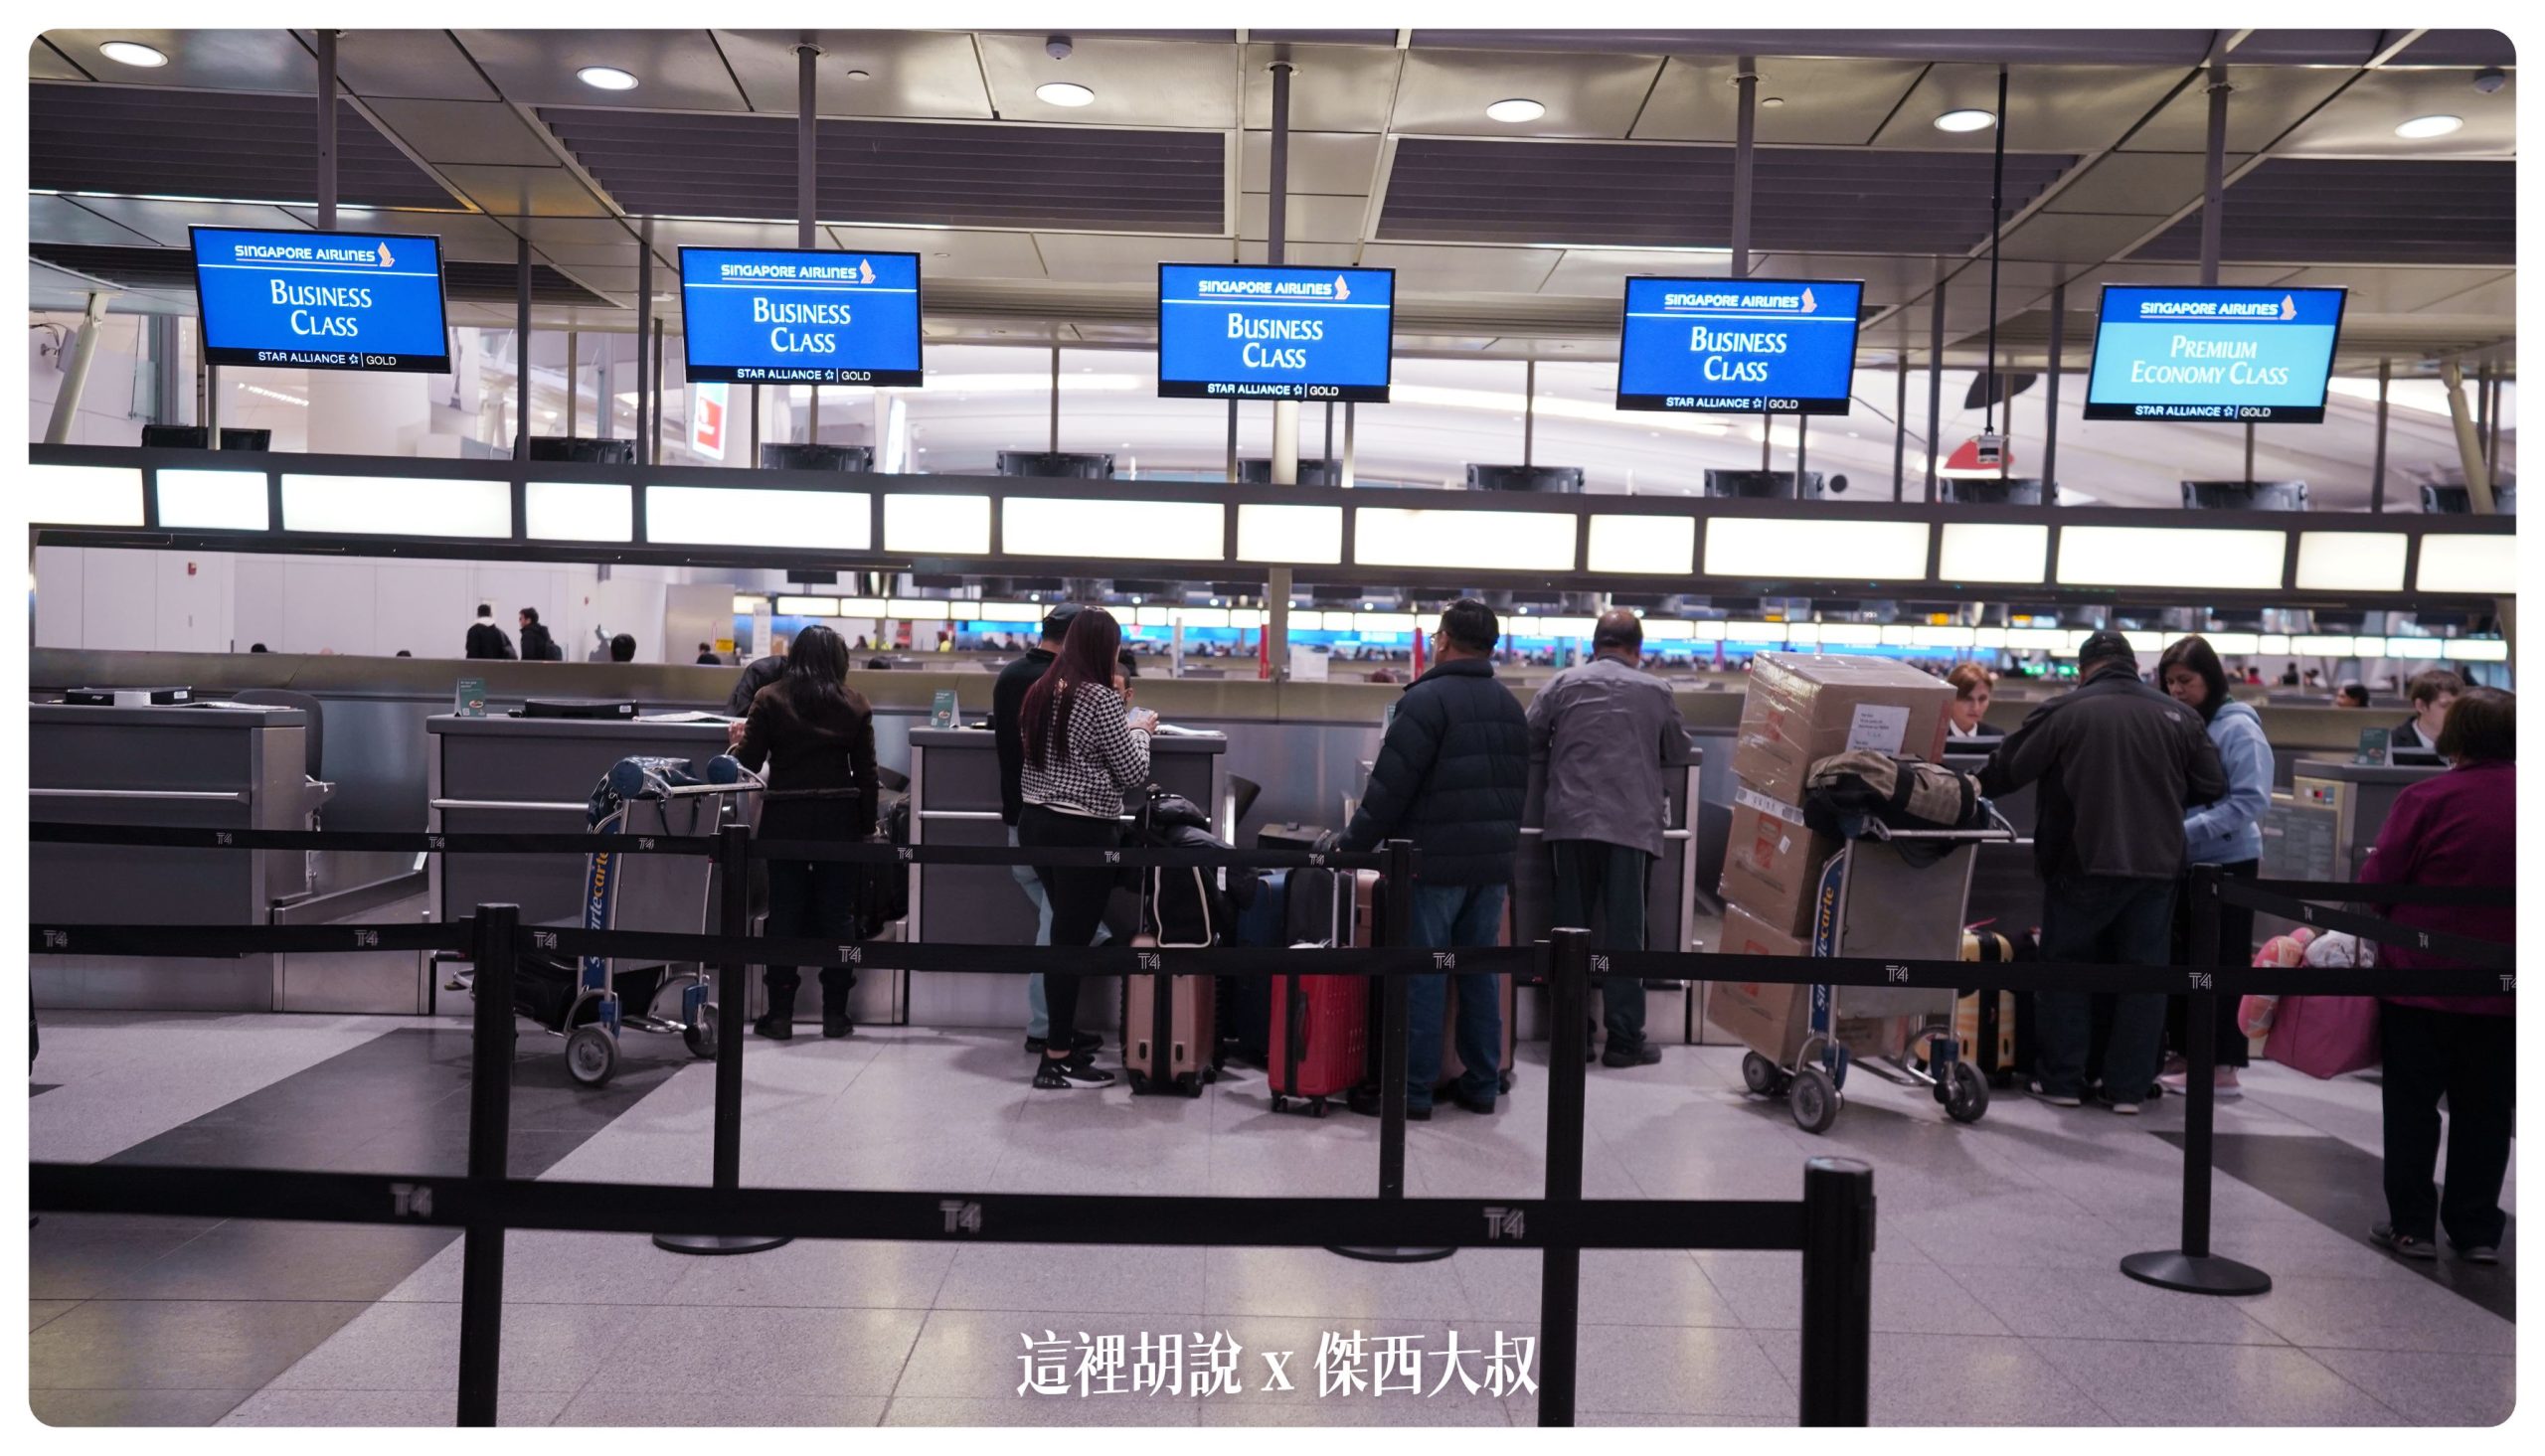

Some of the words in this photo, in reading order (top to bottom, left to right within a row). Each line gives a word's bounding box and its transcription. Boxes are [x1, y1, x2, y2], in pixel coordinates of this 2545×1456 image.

[235, 244, 312, 259] SINGAPORE
[316, 248, 376, 262] AIRLINES
[721, 264, 796, 278] SINGAPORE
[799, 266, 857, 279] AIRLINES
[270, 279, 373, 308] BUSINESS
[1199, 280, 1272, 294] SINGAPORE
[1274, 282, 1332, 295] AIRLINES
[1664, 293, 1739, 307] SINGAPORE
[1741, 295, 1799, 308] AIRLINES
[2140, 301, 2217, 314] SINGAPORE
[2218, 303, 2279, 316] AIRLINES
[754, 297, 851, 325] BUSINESS
[291, 310, 358, 337] CLASS
[1228, 312, 1323, 340] BUSINESS
[770, 327, 836, 354] CLASS
[1690, 326, 1787, 353] BUSINESS
[2170, 334, 2258, 359] PREMIUM
[258, 352, 287, 363] STAR
[290, 353, 346, 365] ALLIANCE
[366, 356, 397, 366] GOLD
[1243, 343, 1306, 369] CLASS
[737, 369, 765, 379] STAR
[767, 370, 822, 380] ALLIANCE
[841, 371, 871, 381] GOLD
[1703, 356, 1768, 382] CLASS
[2130, 361, 2225, 385] ECONOMY
[2229, 362, 2290, 386] CLASS
[1208, 384, 1235, 394] STAR
[1238, 385, 1290, 396] ALLIANCE
[1309, 387, 1339, 397] GOLD
[1666, 398, 1694, 407] STAR
[1696, 398, 1750, 408] ALLIANCE
[1769, 400, 1798, 409] GOLD
[2134, 405, 2164, 415] STAR
[2166, 406, 2221, 416] ALLIANCE
[2240, 407, 2271, 417] GOLD
[216, 832, 233, 845] T4
[428, 836, 445, 849] T4
[638, 837, 655, 851] T4
[897, 847, 914, 860] T4
[1104, 850, 1120, 864] T4
[1308, 853, 1324, 866] T4
[43, 929, 69, 947] T4
[354, 929, 379, 947] T4
[533, 931, 558, 950] T4
[838, 945, 862, 964] T4
[1137, 952, 1161, 971] T4
[1433, 952, 1456, 970] T4
[1885, 965, 1909, 984] T4
[2188, 972, 2213, 991] T4
[390, 1183, 432, 1218] T4
[938, 1200, 981, 1233] T4
[1482, 1207, 1524, 1240] T4
